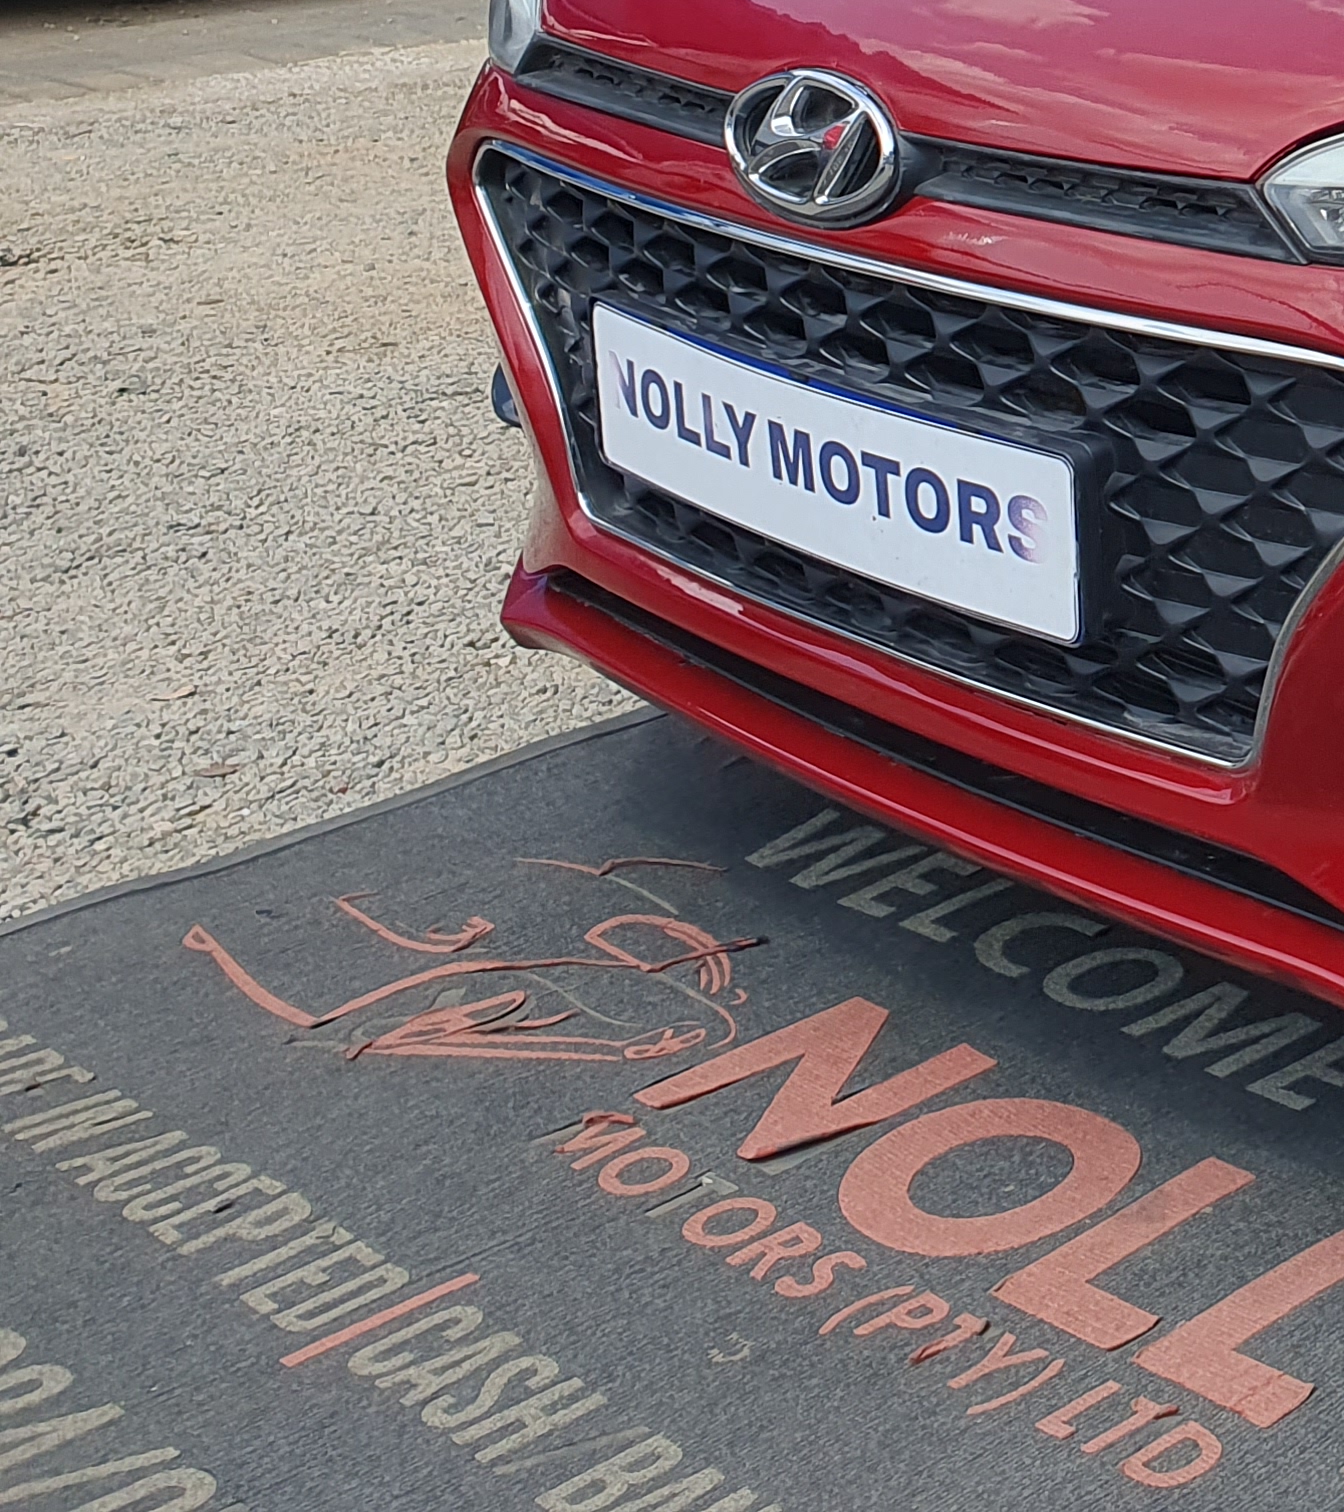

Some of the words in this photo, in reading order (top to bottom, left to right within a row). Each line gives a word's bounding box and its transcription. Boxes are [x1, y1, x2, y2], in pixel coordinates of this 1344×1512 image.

[609, 350, 756, 468] NOLLY
[768, 419, 1048, 564] MOTORS
[3, 1089, 154, 1153] IN
[819, 1285, 1066, 1416] (PTY)
[1034, 1380, 1223, 1489] LTD
